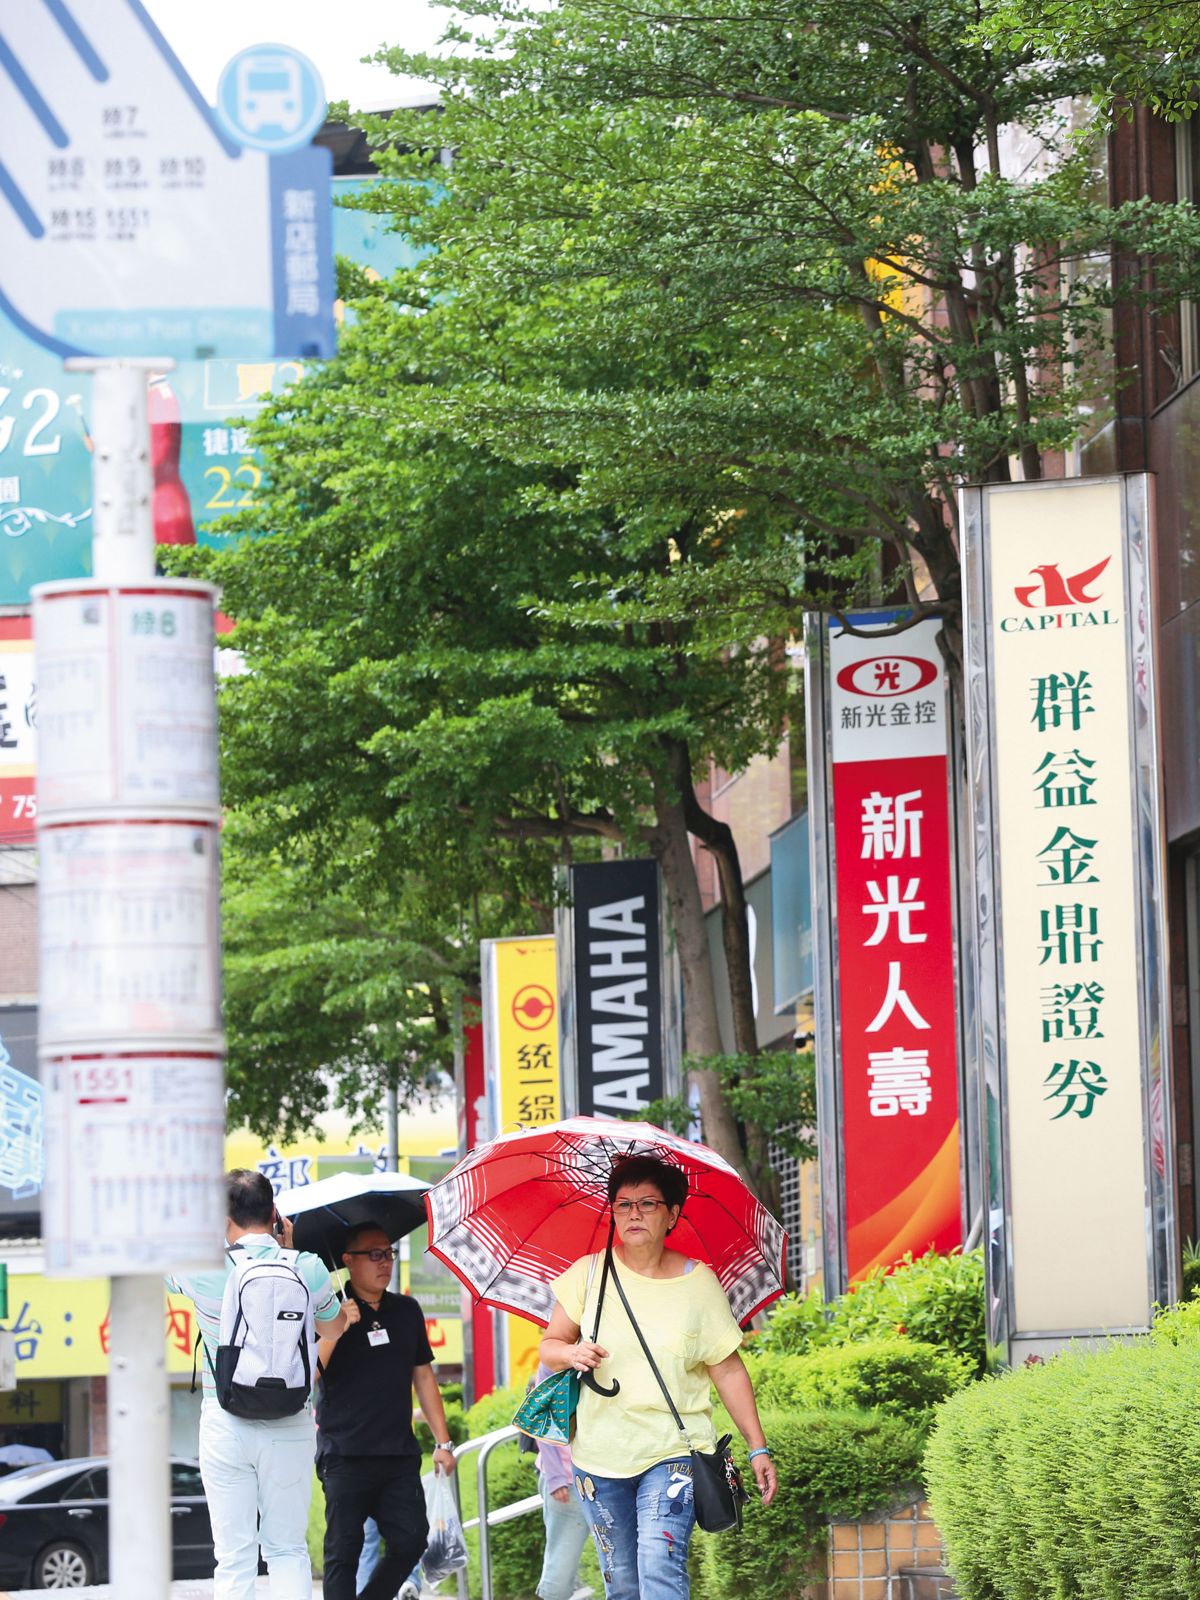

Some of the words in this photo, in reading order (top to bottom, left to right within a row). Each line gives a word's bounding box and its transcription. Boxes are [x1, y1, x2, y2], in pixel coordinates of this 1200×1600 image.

[1000, 610, 1119, 633] CAPITAL
[841, 701, 937, 729] 新光金控
[861, 789, 932, 1117] 新光人壽
[1029, 670, 1108, 1121] 群益金鼎證券
[515, 1042, 556, 1130] 統一綜
[588, 895, 650, 1123] AMAHA
